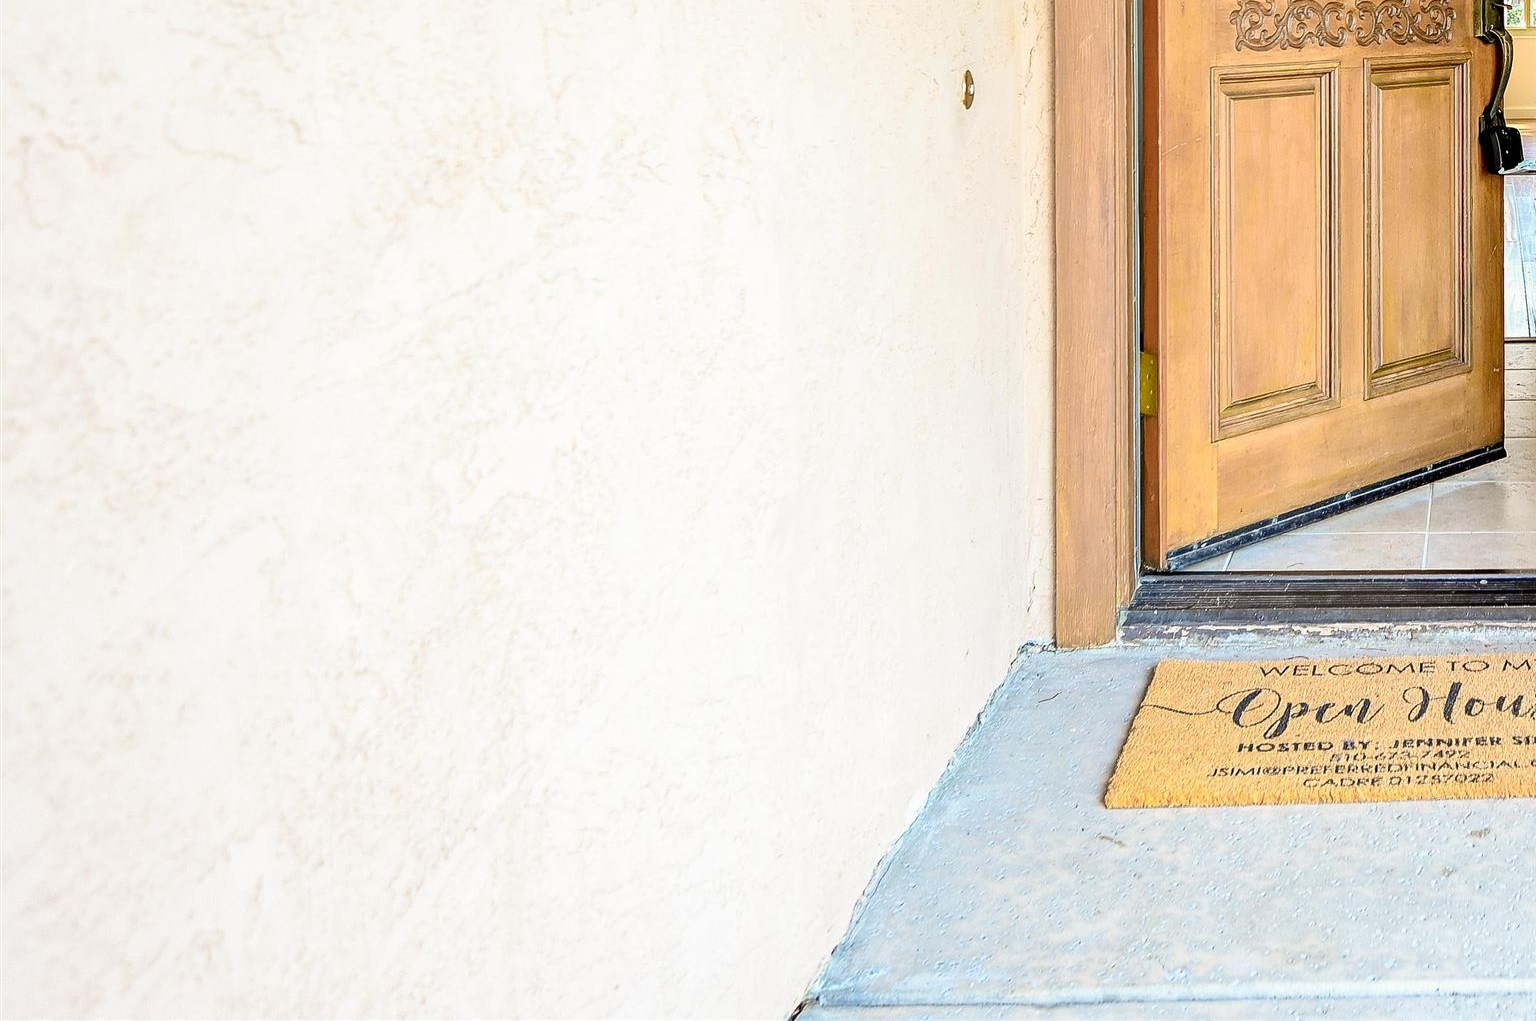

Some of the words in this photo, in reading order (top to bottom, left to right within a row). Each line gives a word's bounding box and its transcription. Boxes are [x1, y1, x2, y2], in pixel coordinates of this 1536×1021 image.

[1259, 661, 1436, 677] WELCOME
[1447, 660, 1490, 672] TO
[1216, 687, 1386, 740] Open
[1237, 741, 1334, 753] HOSTED
[1342, 739, 1380, 751] BY:
[1388, 736, 1502, 749] JENNIFER
